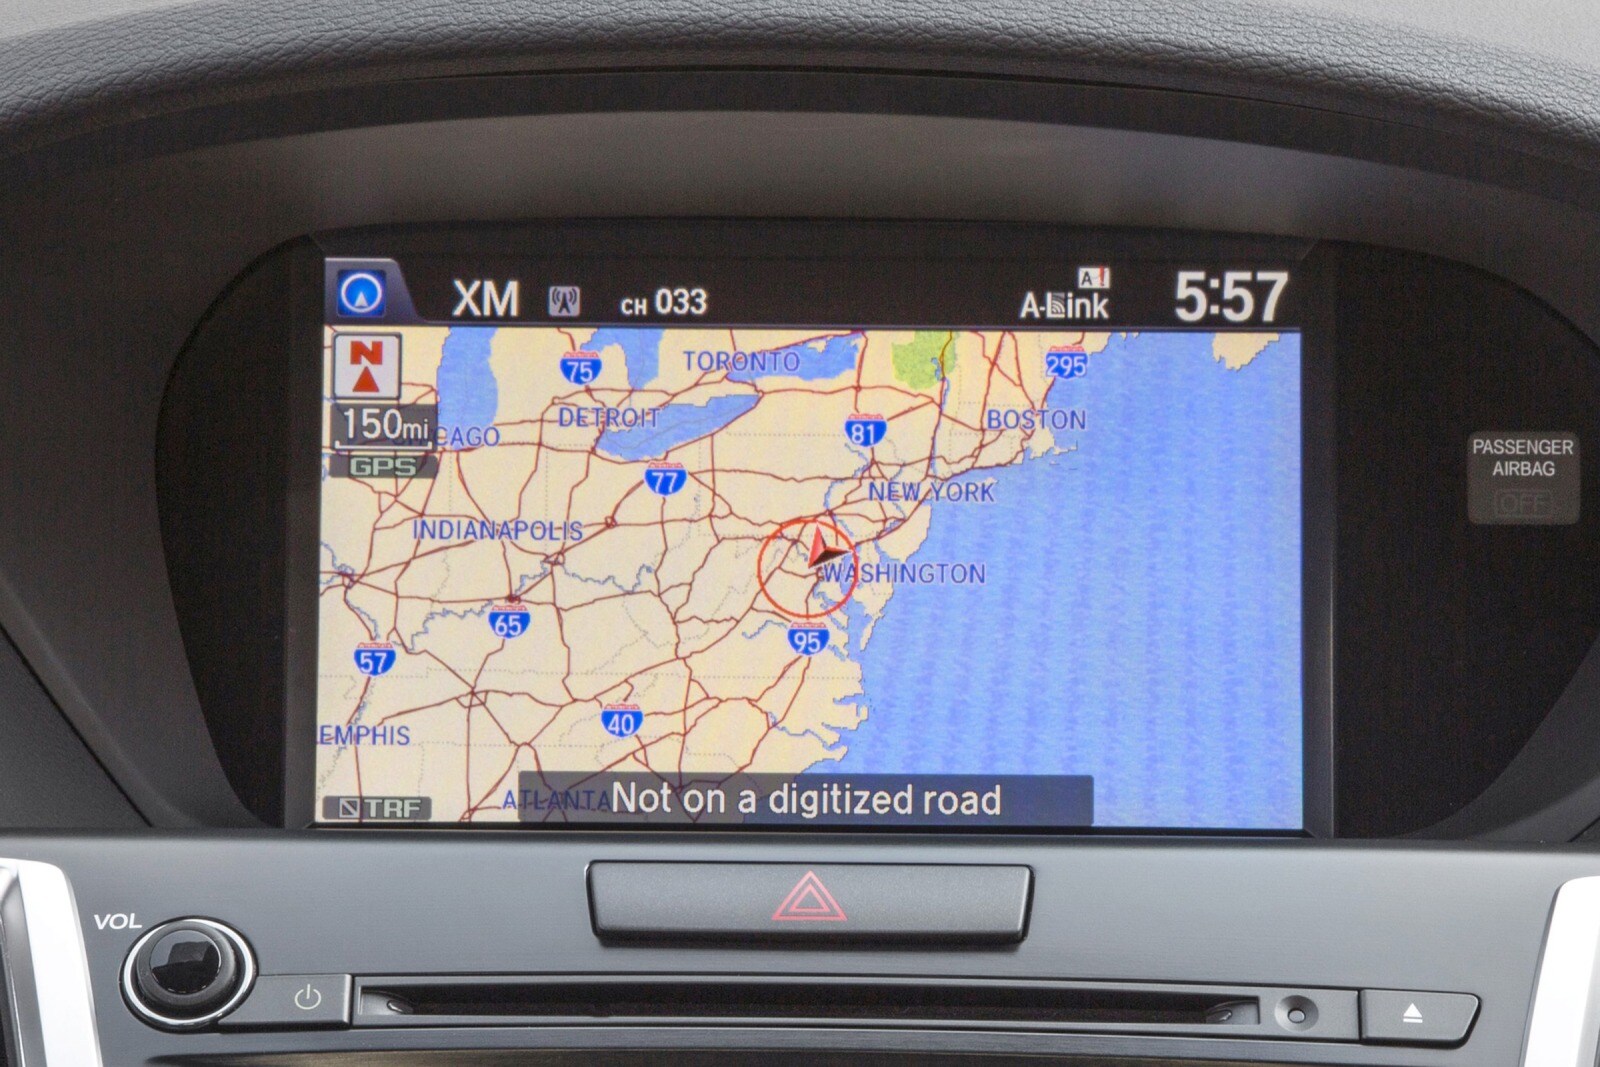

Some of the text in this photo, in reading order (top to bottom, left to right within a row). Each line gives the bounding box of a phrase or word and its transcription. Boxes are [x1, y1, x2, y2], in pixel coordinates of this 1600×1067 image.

[453, 280, 520, 317] XM
[621, 288, 708, 316] CH 033
[1020, 292, 1109, 319] A-Link
[1175, 271, 1289, 322] 5:57
[350, 341, 383, 365] N
[684, 351, 800, 371] TORONTO
[567, 362, 593, 382] 75
[1048, 356, 1086, 377] 295
[559, 407, 661, 428] DETROIT
[987, 409, 1087, 430] BOSTON
[393, 426, 501, 447] CAGO
[851, 424, 875, 444] 81
[1473, 439, 1574, 455] PASSENGER
[350, 457, 416, 476] GPS
[1492, 461, 1556, 477] AIRBAG
[651, 472, 678, 493] 77
[869, 482, 995, 502] NEW YORK
[413, 519, 583, 541] INDIANAPOLIS
[824, 563, 986, 584] WASHINGTON
[495, 616, 522, 636] 65
[794, 632, 821, 653] 95
[360, 652, 387, 674] 57
[608, 713, 635, 735] 40
[319, 725, 410, 746] EMPHIS
[364, 799, 421, 818] TRF
[502, 789, 612, 811] ATLANTA
[612, 782, 1001, 819] Not on a digitized road
[93, 912, 143, 930] VOL
